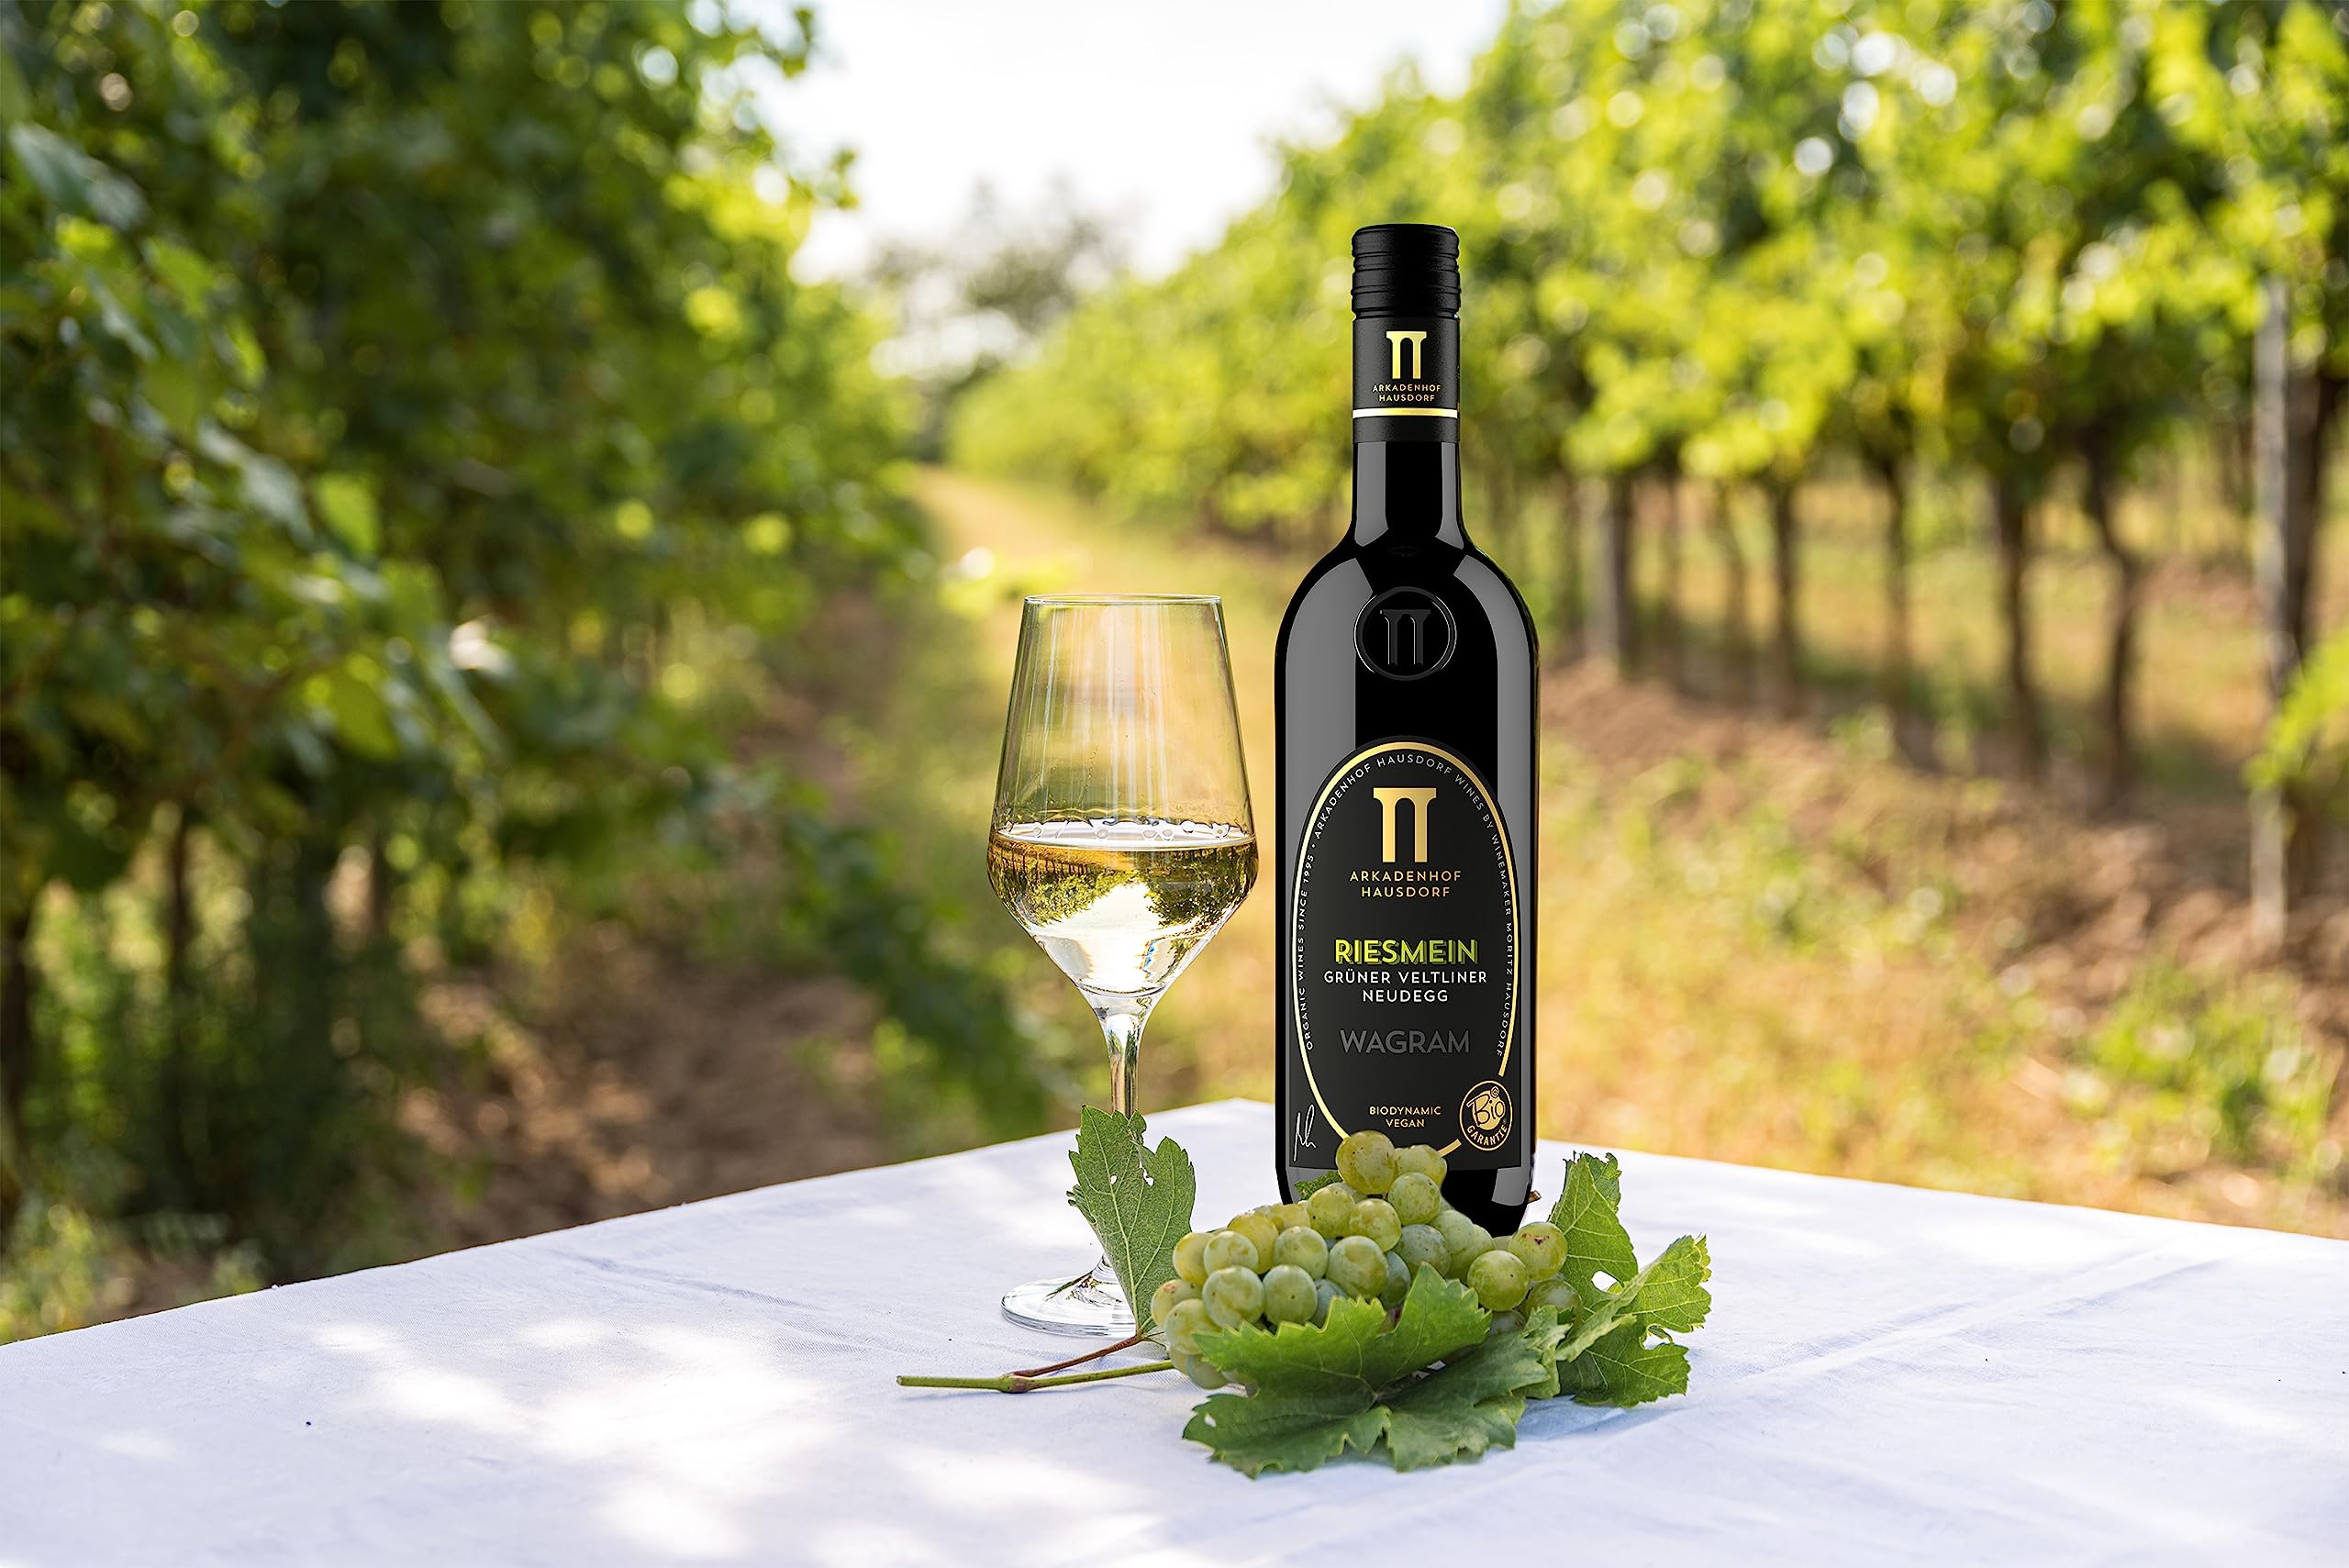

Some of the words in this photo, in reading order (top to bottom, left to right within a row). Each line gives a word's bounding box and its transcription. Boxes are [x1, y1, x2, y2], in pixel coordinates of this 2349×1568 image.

[1372, 384, 1442, 393] ARKADENHOF
[1379, 394, 1435, 402] HAUSDORF
[1376, 753, 1453, 774] HAUSDORF
[1314, 762, 1372, 840] ARKADENHOF
[1454, 773, 1485, 811] WINES
[1482, 814, 1494, 829] BY
[1350, 870, 1462, 882] ARKADENHOF
[1491, 833, 1511, 916] WINEMAKER
[1361, 886, 1450, 897] HAUSDORF
[1297, 889, 1308, 930] SINCE
[1335, 939, 1478, 965] RIESMEIN
[1323, 968, 1391, 984] GRÜNER
[1398, 971, 1487, 984] VELTLINER
[1363, 989, 1448, 1003] NEUDEGG
[1298, 987, 1313, 1051] ORGANIC
[1496, 982, 1512, 1057] HAUSDORF
[1340, 1029, 1470, 1054] WAGRAM
[1369, 1106, 1442, 1116] BIODYNAMIC
[1386, 1118, 1425, 1128] VEGAN
[1467, 1125, 1508, 1146] GARANTIE
